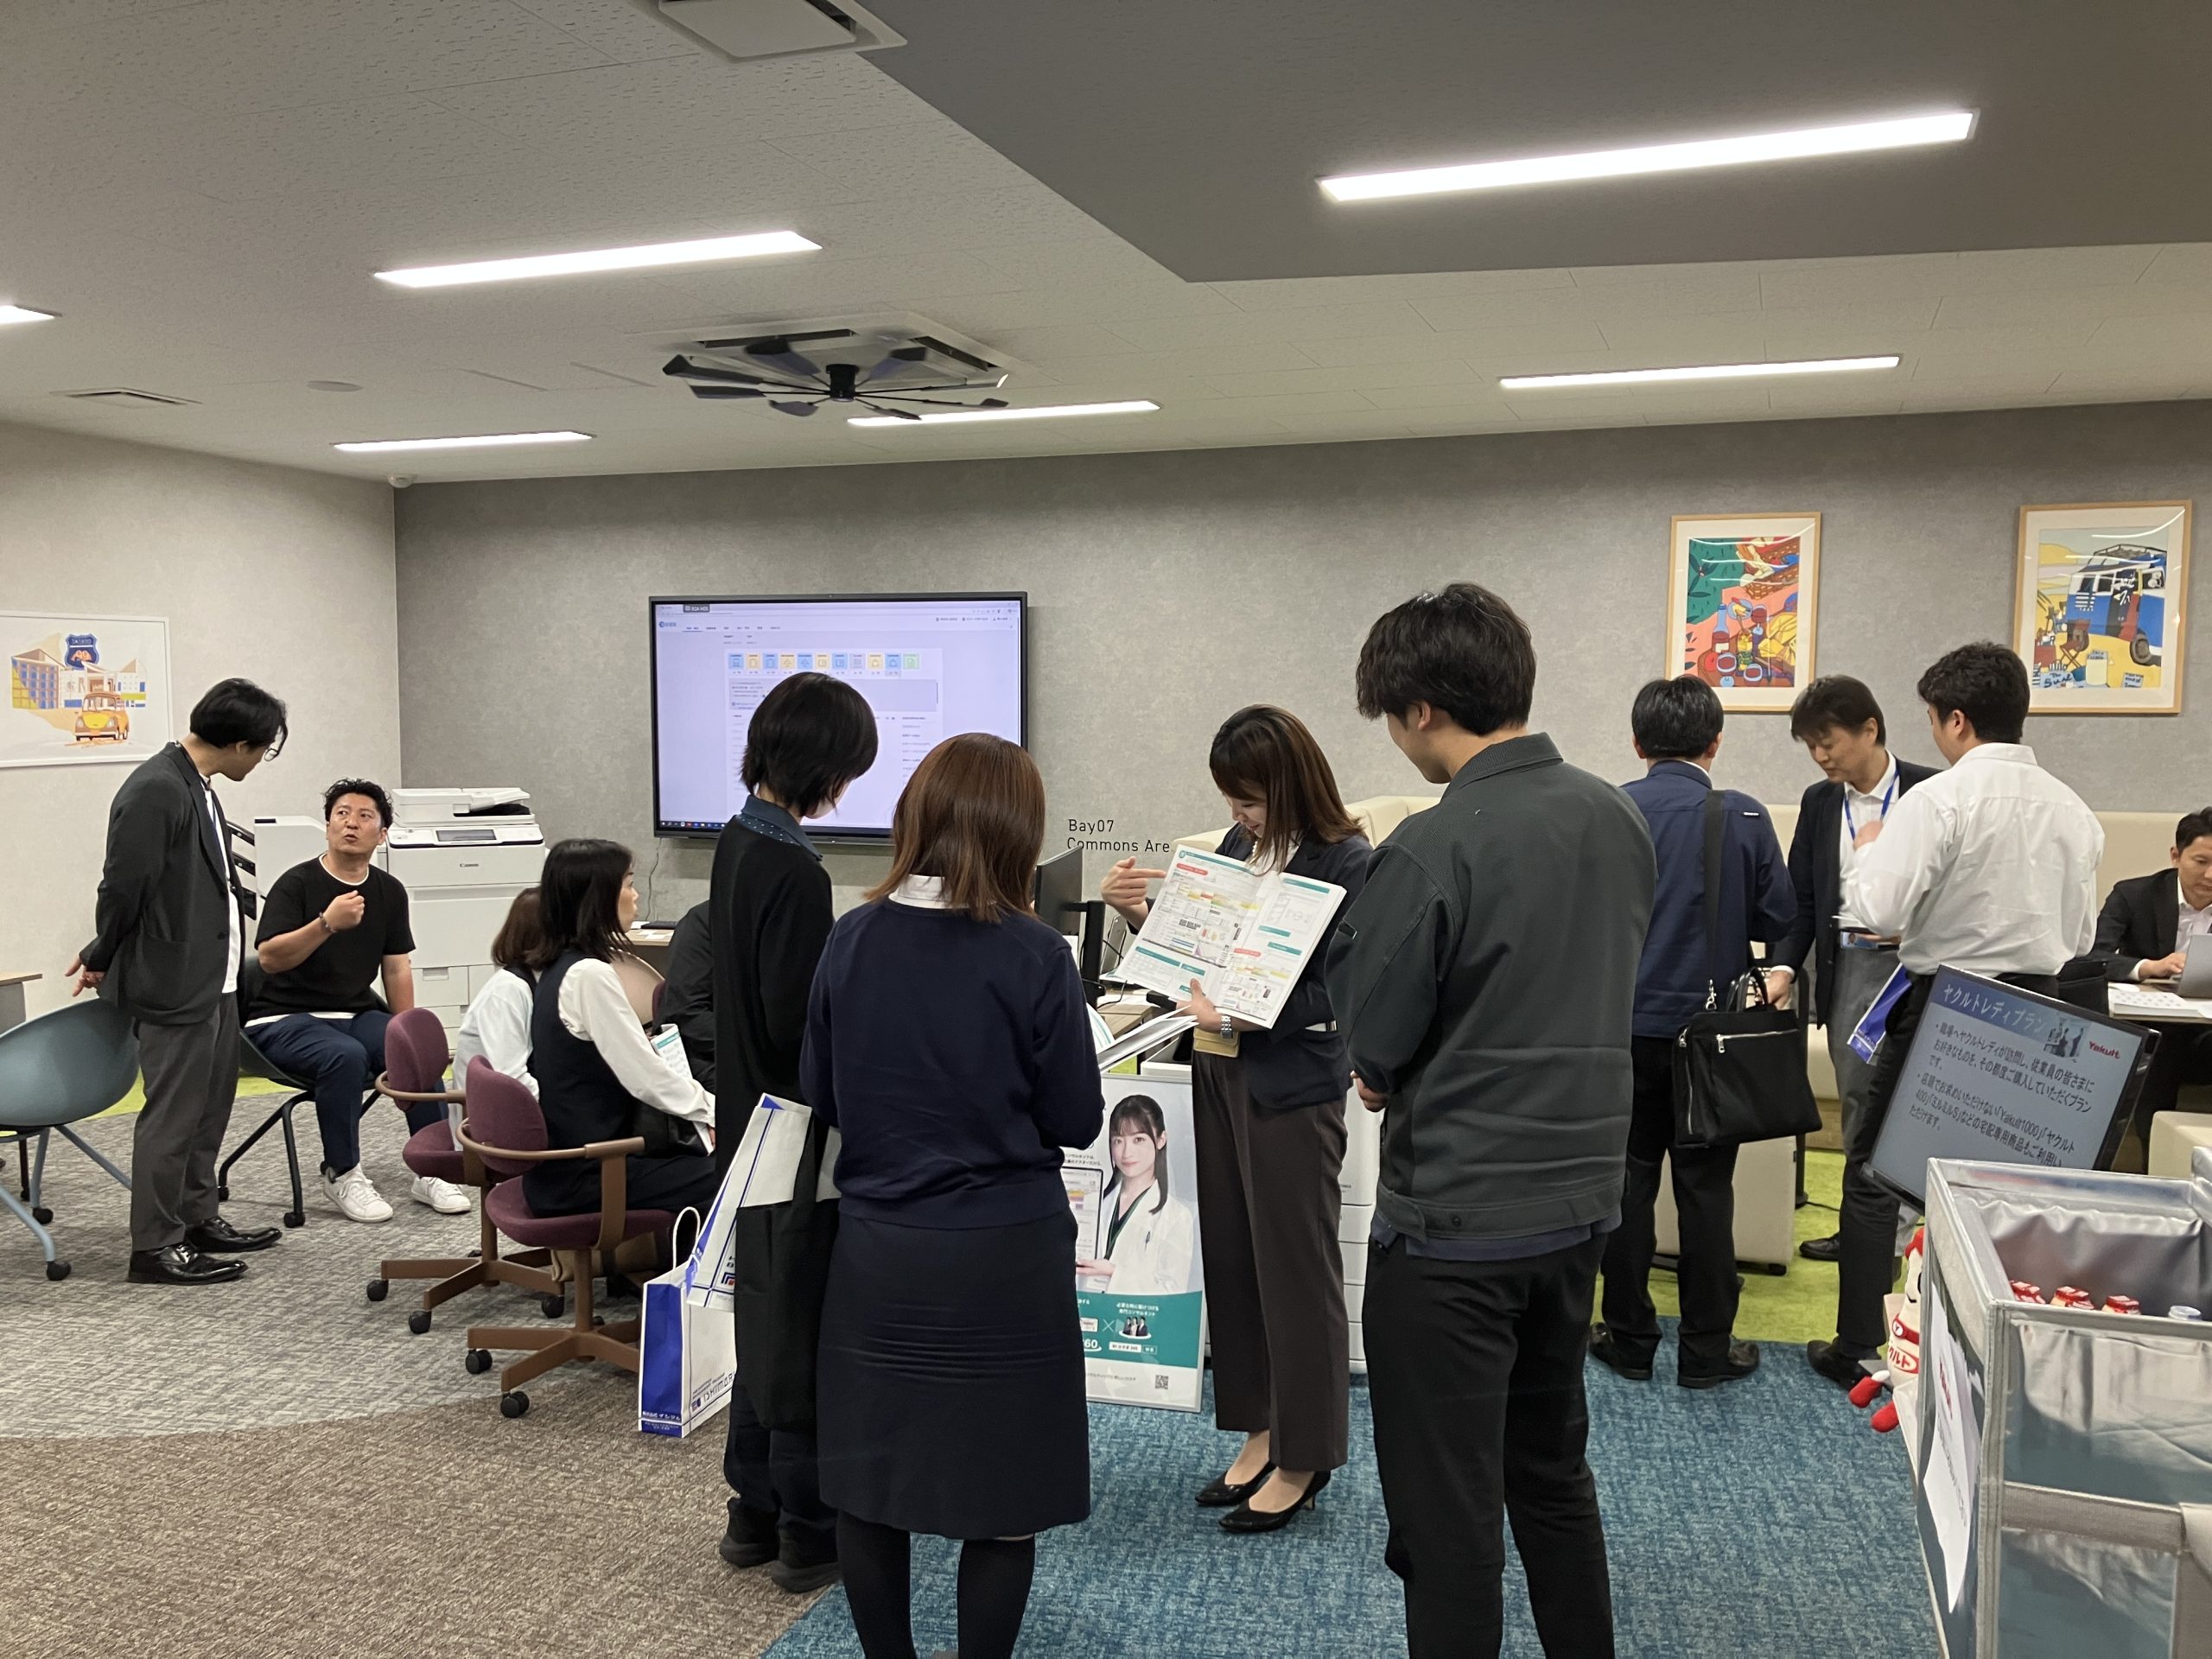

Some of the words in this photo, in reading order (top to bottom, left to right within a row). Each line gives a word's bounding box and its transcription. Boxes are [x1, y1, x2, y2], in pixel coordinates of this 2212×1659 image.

[1068, 818, 1114, 835] Bay07
[1067, 836, 1139, 852] Commons
[1145, 840, 1173, 852] Are
[1943, 983, 2046, 1033] ヤクルトレディプラン
[2089, 1040, 2120, 1059] Yakult
[1083, 1338, 1098, 1349] 60
